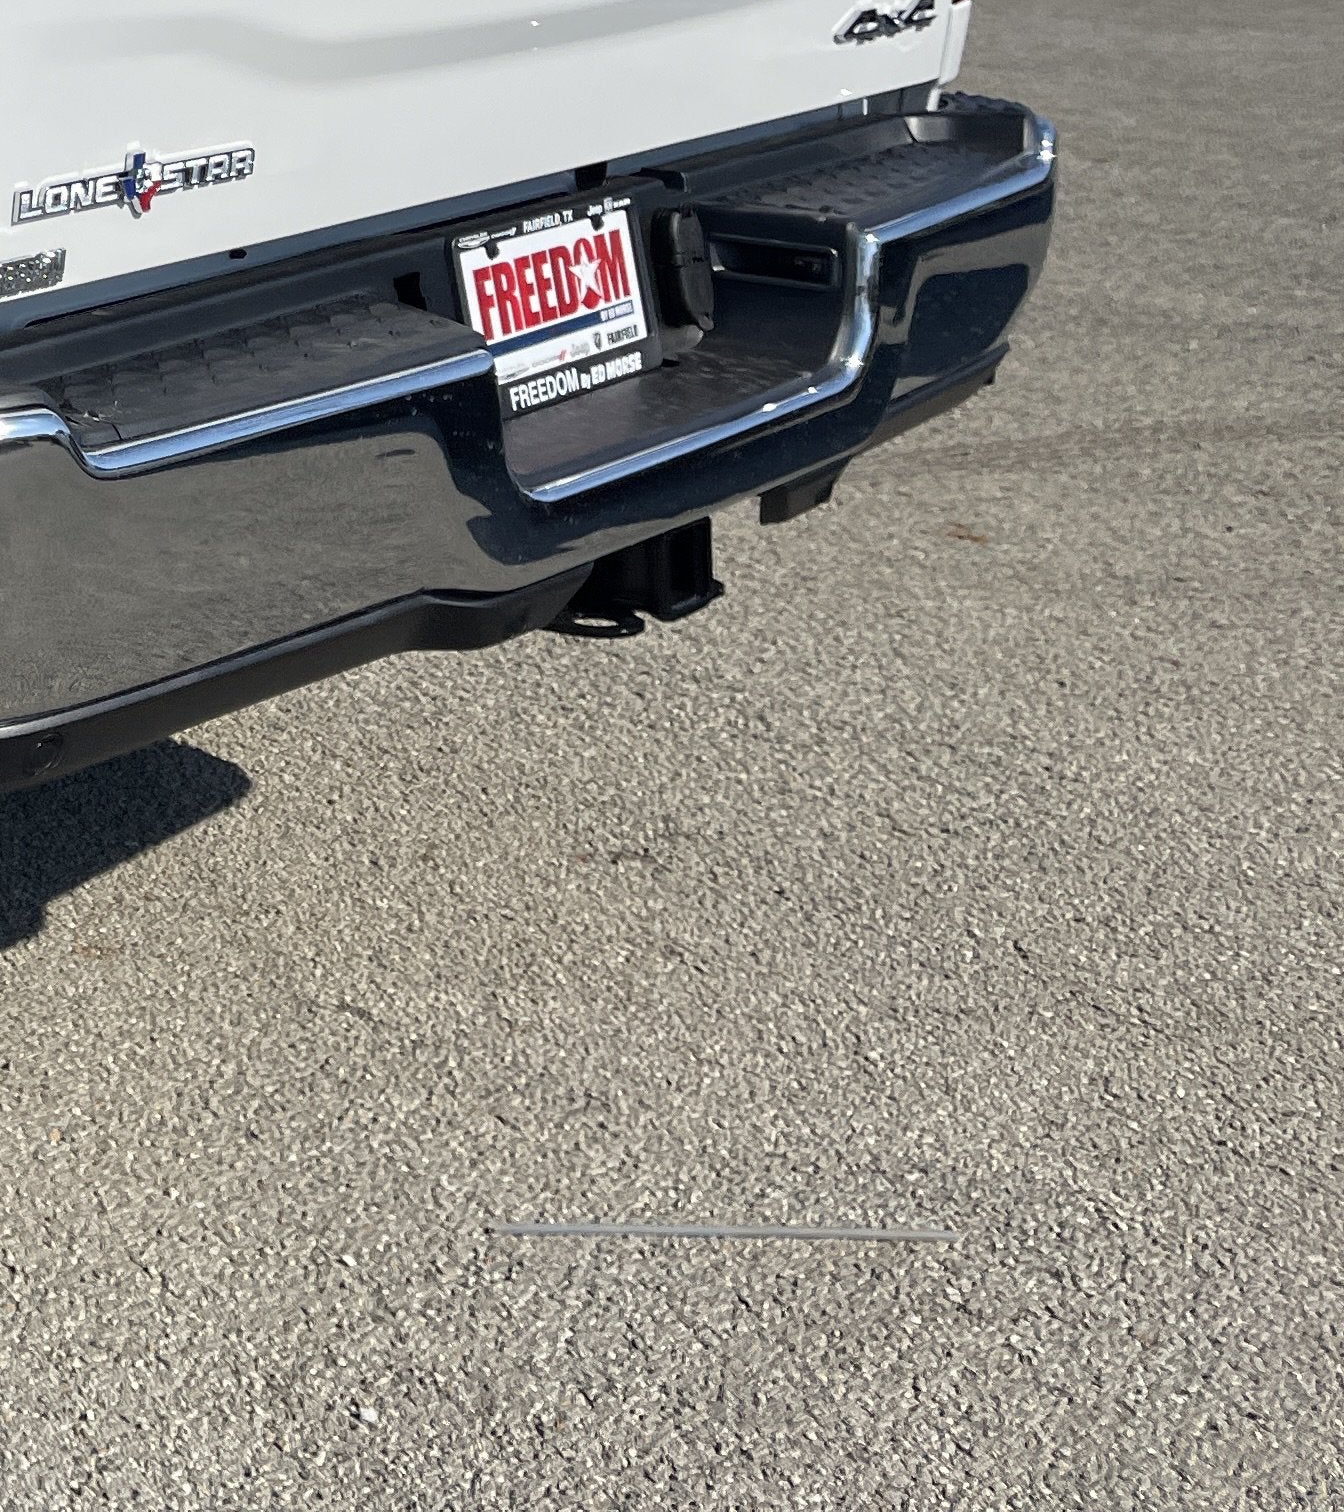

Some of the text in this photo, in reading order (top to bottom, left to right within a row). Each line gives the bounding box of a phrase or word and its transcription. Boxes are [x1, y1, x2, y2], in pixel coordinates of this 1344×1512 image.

[13, 148, 256, 225] LONE STAR
[562, 209, 574, 223] TX
[472, 229, 631, 341] FREEDOM
[509, 366, 580, 412] FREEDOM
[590, 363, 606, 385] ED
[605, 351, 643, 381] MORSE
